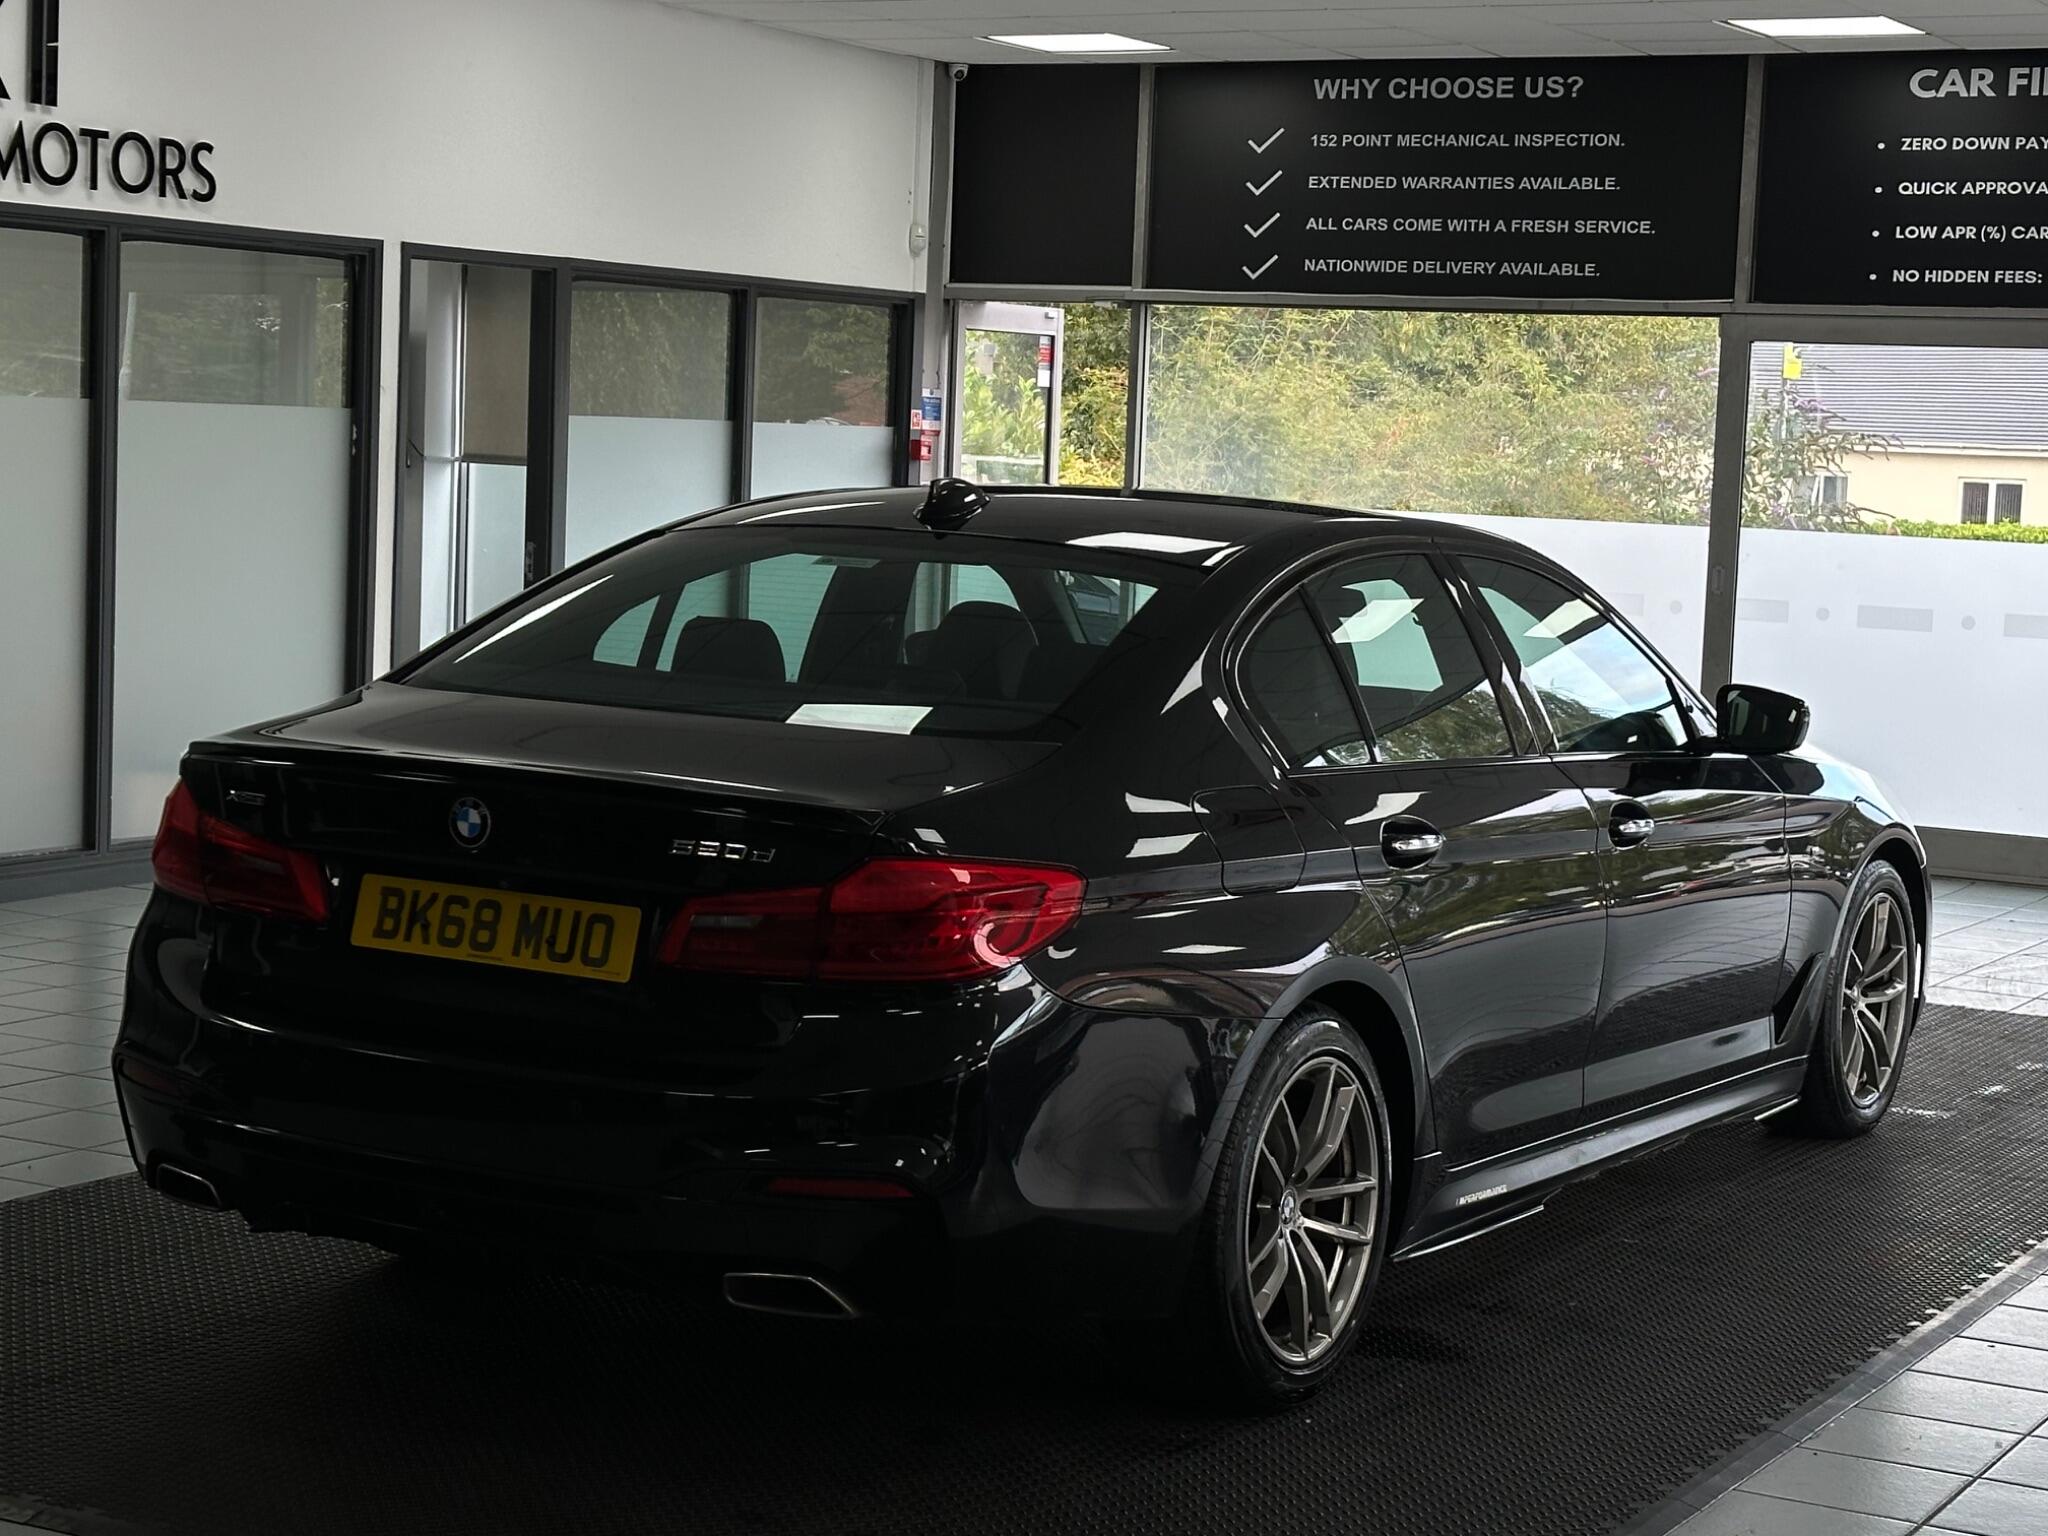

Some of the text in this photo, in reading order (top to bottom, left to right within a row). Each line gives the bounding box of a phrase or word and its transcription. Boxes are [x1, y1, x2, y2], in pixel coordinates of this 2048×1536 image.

[1313, 75, 1584, 100] WHY CHOOSE US?
[1909, 66, 2048, 99] CAR FI
[1310, 133, 1625, 147] 152 POINT MECHANICAL INSPECTION.
[1900, 137, 1948, 151] ZERO
[1951, 136, 2010, 151] DOWN
[1308, 175, 1621, 190] EXTENDED WARRANTIES AVAILABLE.
[1898, 181, 1958, 195] QUICK
[1305, 217, 1656, 234] ALL CARS COME WITH A FRESH SERVICE.
[1895, 225, 1938, 239] LOW
[1941, 225, 1977, 240] APR
[1980, 224, 2007, 243] (%)
[1304, 258, 1600, 277] NATIONWIDE DELIVERY AVAILABLE.
[1892, 269, 2043, 284] NO HIDDEN FEES:
[372, 886, 615, 968] BK68 MUO
